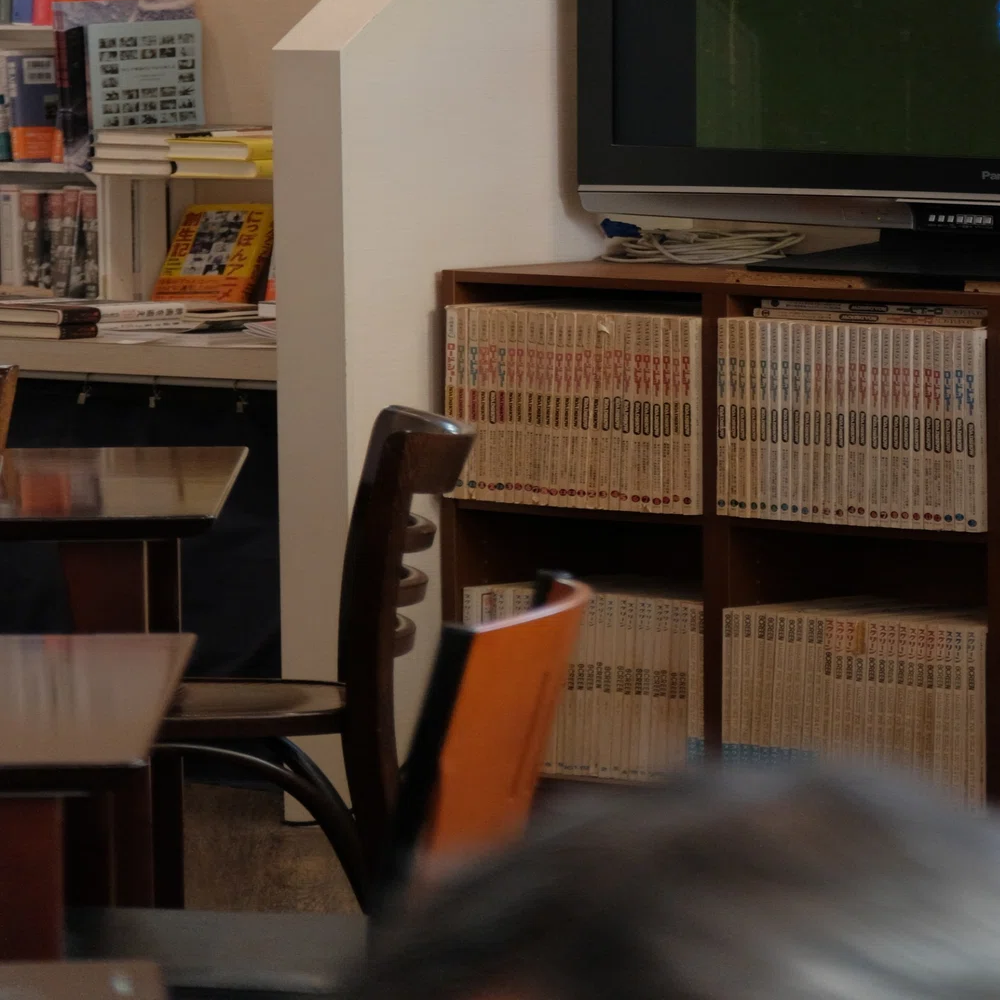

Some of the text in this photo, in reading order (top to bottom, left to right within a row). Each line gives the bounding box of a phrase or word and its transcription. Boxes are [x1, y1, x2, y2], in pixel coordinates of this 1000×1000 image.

[825, 620, 833, 650] スクリーン
[835, 622, 844, 652] スクリーン
[846, 622, 855, 652] スクリーン
[869, 624, 877, 654] スクリーン
[908, 628, 916, 659] スクリーン
[926, 631, 934, 661] スクリーン
[937, 631, 945, 661] スクリーン
[967, 632, 975, 663] スクリーン
